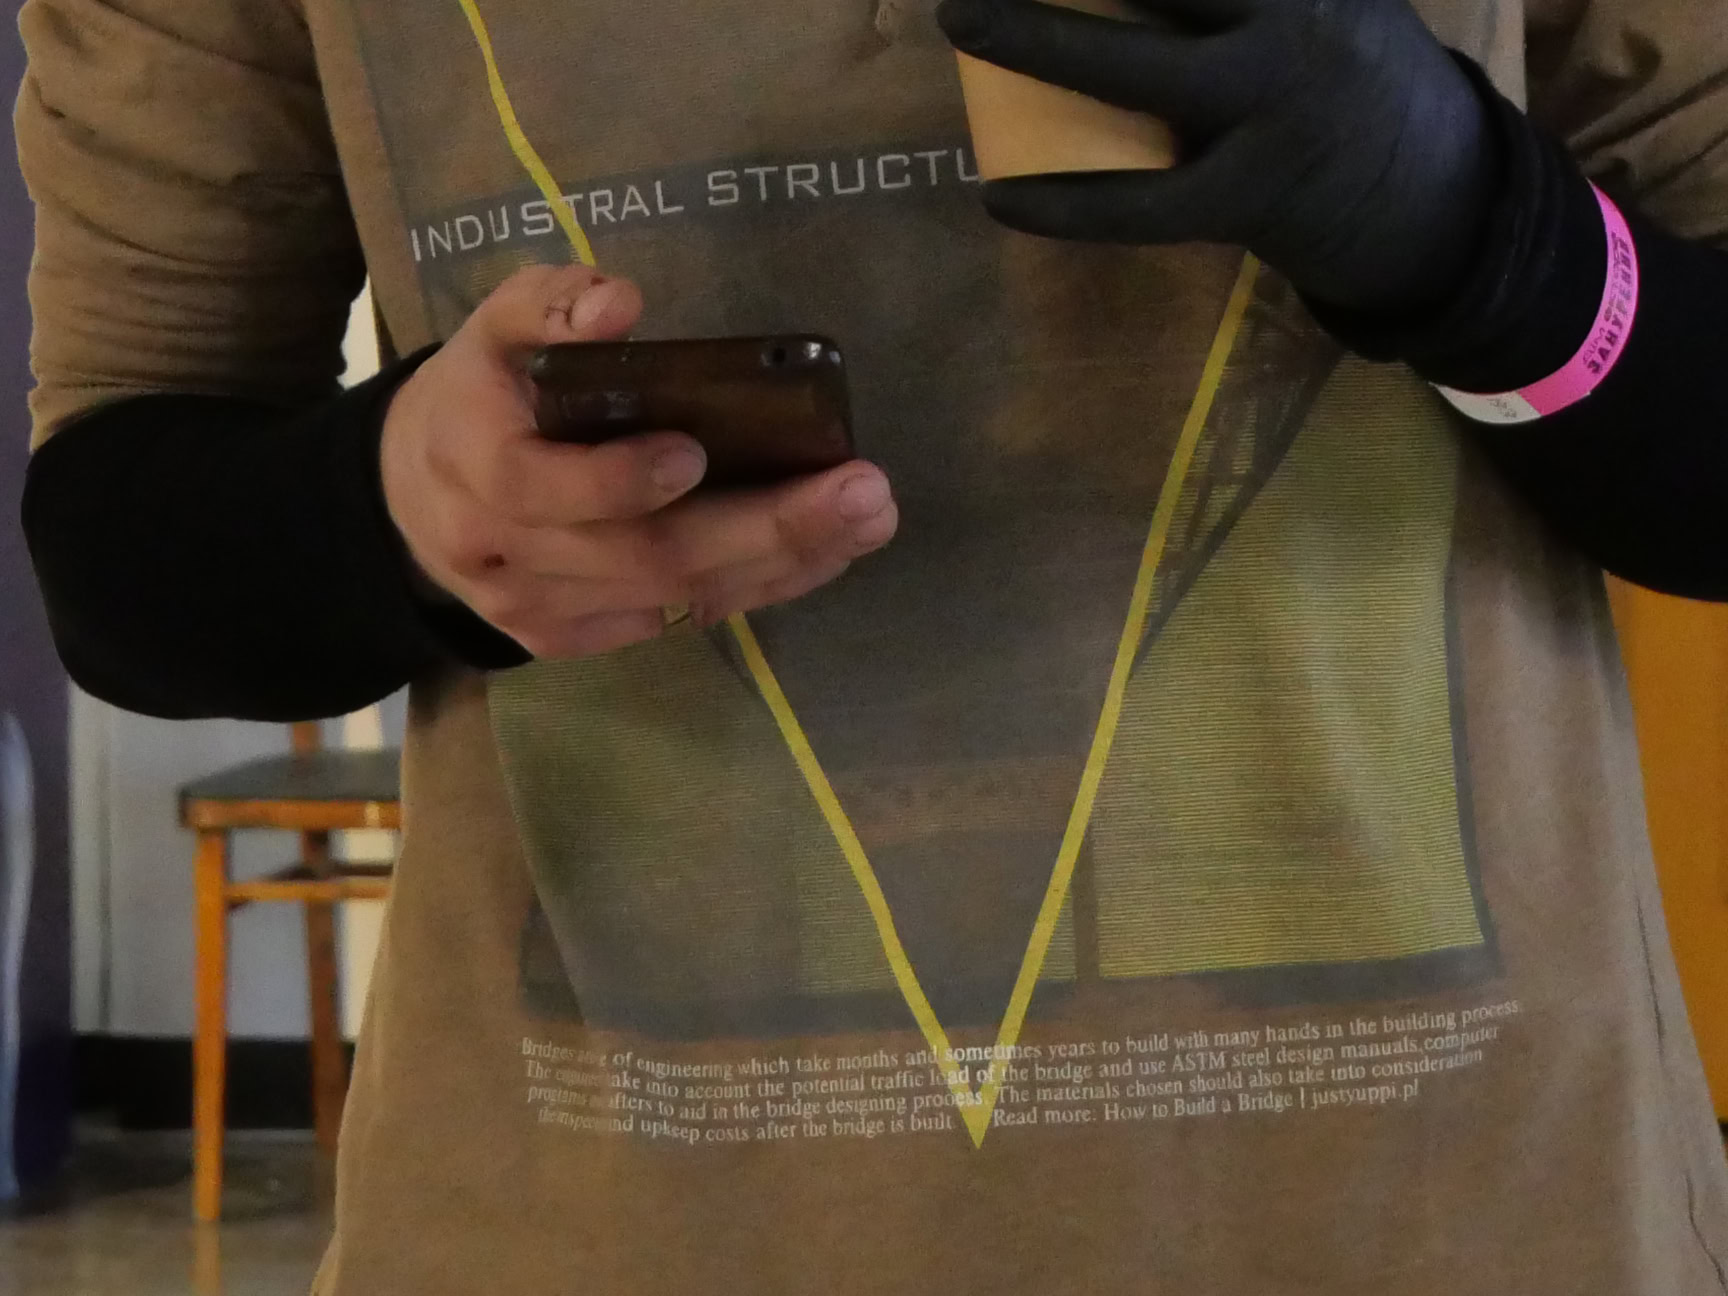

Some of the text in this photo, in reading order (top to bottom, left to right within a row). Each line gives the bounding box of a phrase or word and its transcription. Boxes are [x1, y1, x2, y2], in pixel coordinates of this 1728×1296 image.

[522, 1036, 575, 1063] Bridges
[613, 1051, 634, 1067] of
[636, 1057, 734, 1081] engineering
[738, 1057, 790, 1077] which
[795, 1055, 831, 1074] take
[836, 1049, 899, 1070] months
[906, 1045, 938, 1066] and
[945, 1043, 1042, 1063] sometimes
[1048, 1040, 1096, 1061] years
[1102, 1039, 1121, 1056] to
[1125, 1033, 1169, 1054] build
[1174, 1029, 1209, 1051] with
[1213, 1028, 1261, 1048] many
[1265, 1022, 1321, 1044] hands
[1325, 1020, 1345, 1038] in
[1350, 1017, 1377, 1036] the
[1382, 1011, 1458, 1034] building
[611, 1069, 641, 1090] ake
[646, 1080, 680, 1098] into
[684, 1083, 752, 1100] account
[757, 1078, 785, 1098] the
[792, 1074, 866, 1099] potential
[871, 1069, 925, 1091] traffic
[976, 1063, 997, 1084] of
[1002, 1063, 1030, 1083] the
[1035, 1061, 1094, 1084] bridge
[1098, 1059, 1133, 1079] and
[1138, 1060, 1166, 1076] use
[1172, 1051, 1226, 1074] ASTM
[1231, 1048, 1270, 1068] steel
[1275, 1044, 1336, 1068] design
[1424, 1025, 1500, 1053] computer
[640, 1119, 700, 1145] upkeep
[705, 1126, 750, 1142] costs
[756, 1121, 798, 1141] after
[802, 1118, 828, 1138] the
[832, 1114, 886, 1139] bridge
[890, 1114, 904, 1133] is
[993, 1106, 1038, 1128] Read
[1104, 1102, 1148, 1122] How
[1152, 1102, 1169, 1120] to
[1174, 1095, 1217, 1117] Build
[1221, 1100, 1232, 1114] a
[1238, 1092, 1294, 1114] Bridge
[1310, 1077, 1420, 1111] justyuppi.pl
[658, 1100, 675, 1117] to
[679, 1103, 707, 1120] aid
[713, 1103, 728, 1120] in
[733, 1101, 760, 1120] the
[766, 1096, 821, 1120] bridge
[826, 1090, 908, 1116] designing
[995, 1084, 1030, 1105] The
[1036, 1080, 1121, 1103] materials
[1125, 1076, 1183, 1098] chosen
[1188, 1070, 1244, 1094] should
[1248, 1068, 1283, 1089] also
[1288, 1063, 1325, 1084] take
[1330, 1061, 1366, 1081] into
[1371, 1047, 1484, 1078] consideration
